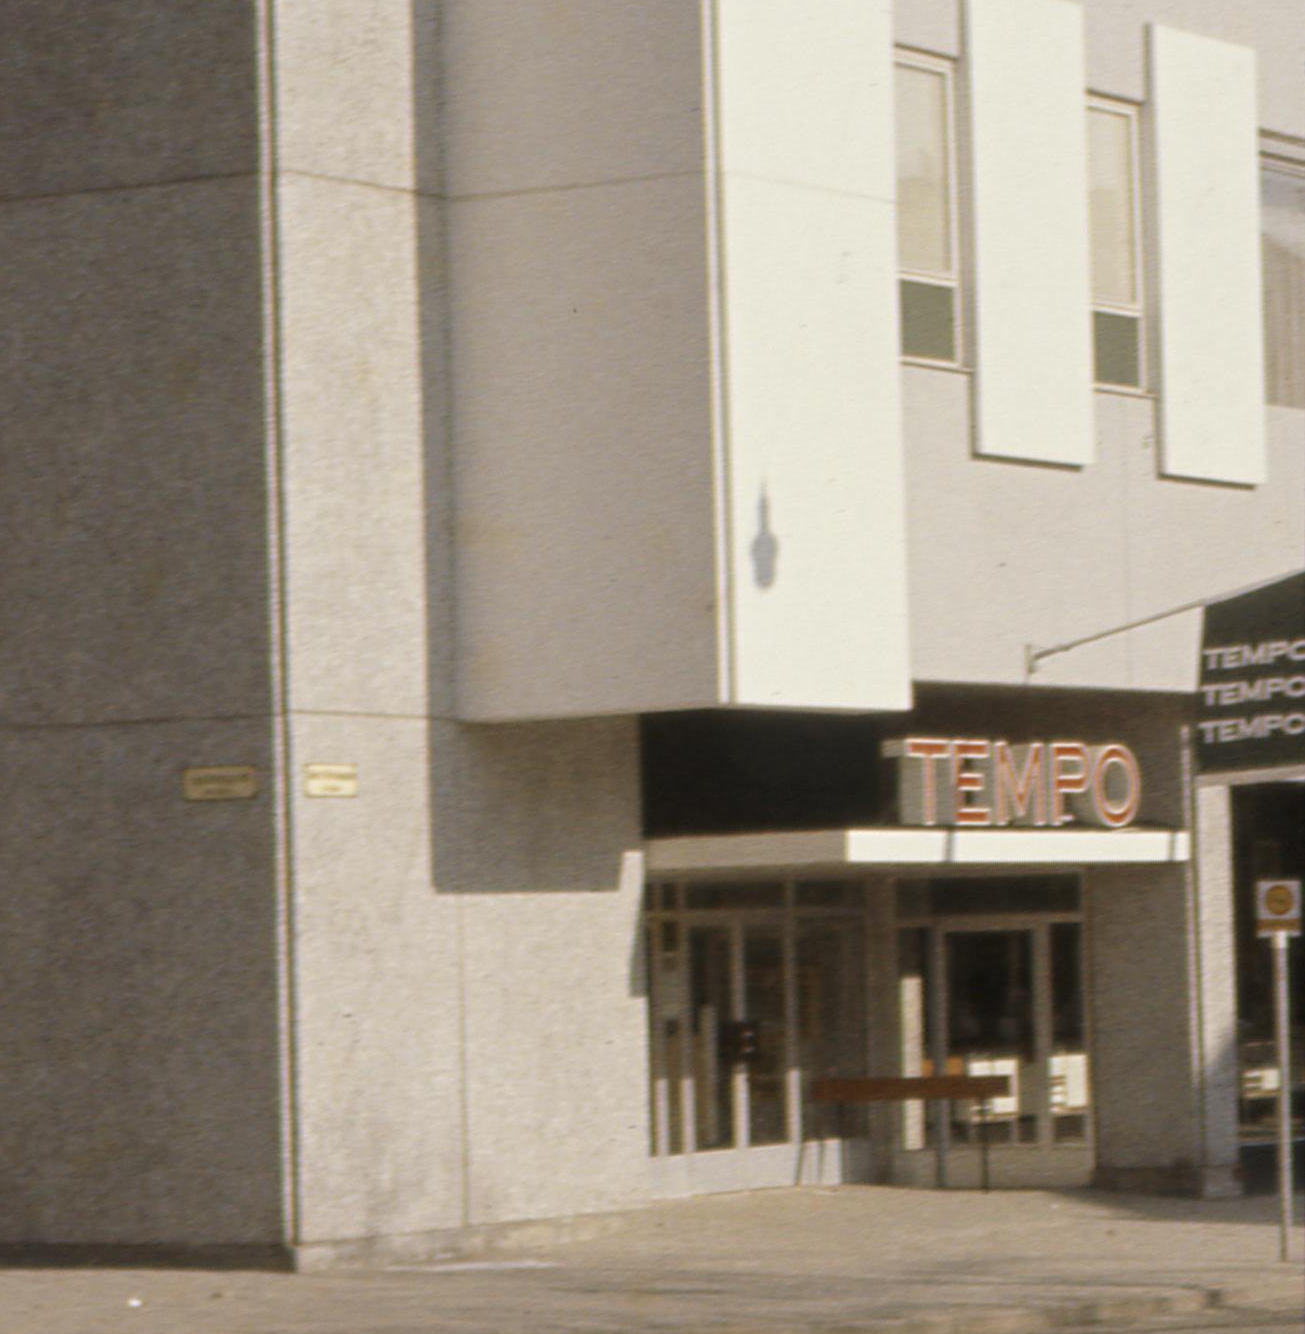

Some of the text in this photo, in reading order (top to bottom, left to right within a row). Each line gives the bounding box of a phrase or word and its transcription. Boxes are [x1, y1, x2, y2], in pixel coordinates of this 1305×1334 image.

[1202, 639, 1305, 669] TEMPO
[1200, 676, 1305, 706] TEMPO
[1198, 714, 1305, 743] TEMPO
[904, 738, 1141, 827] TEMPO
